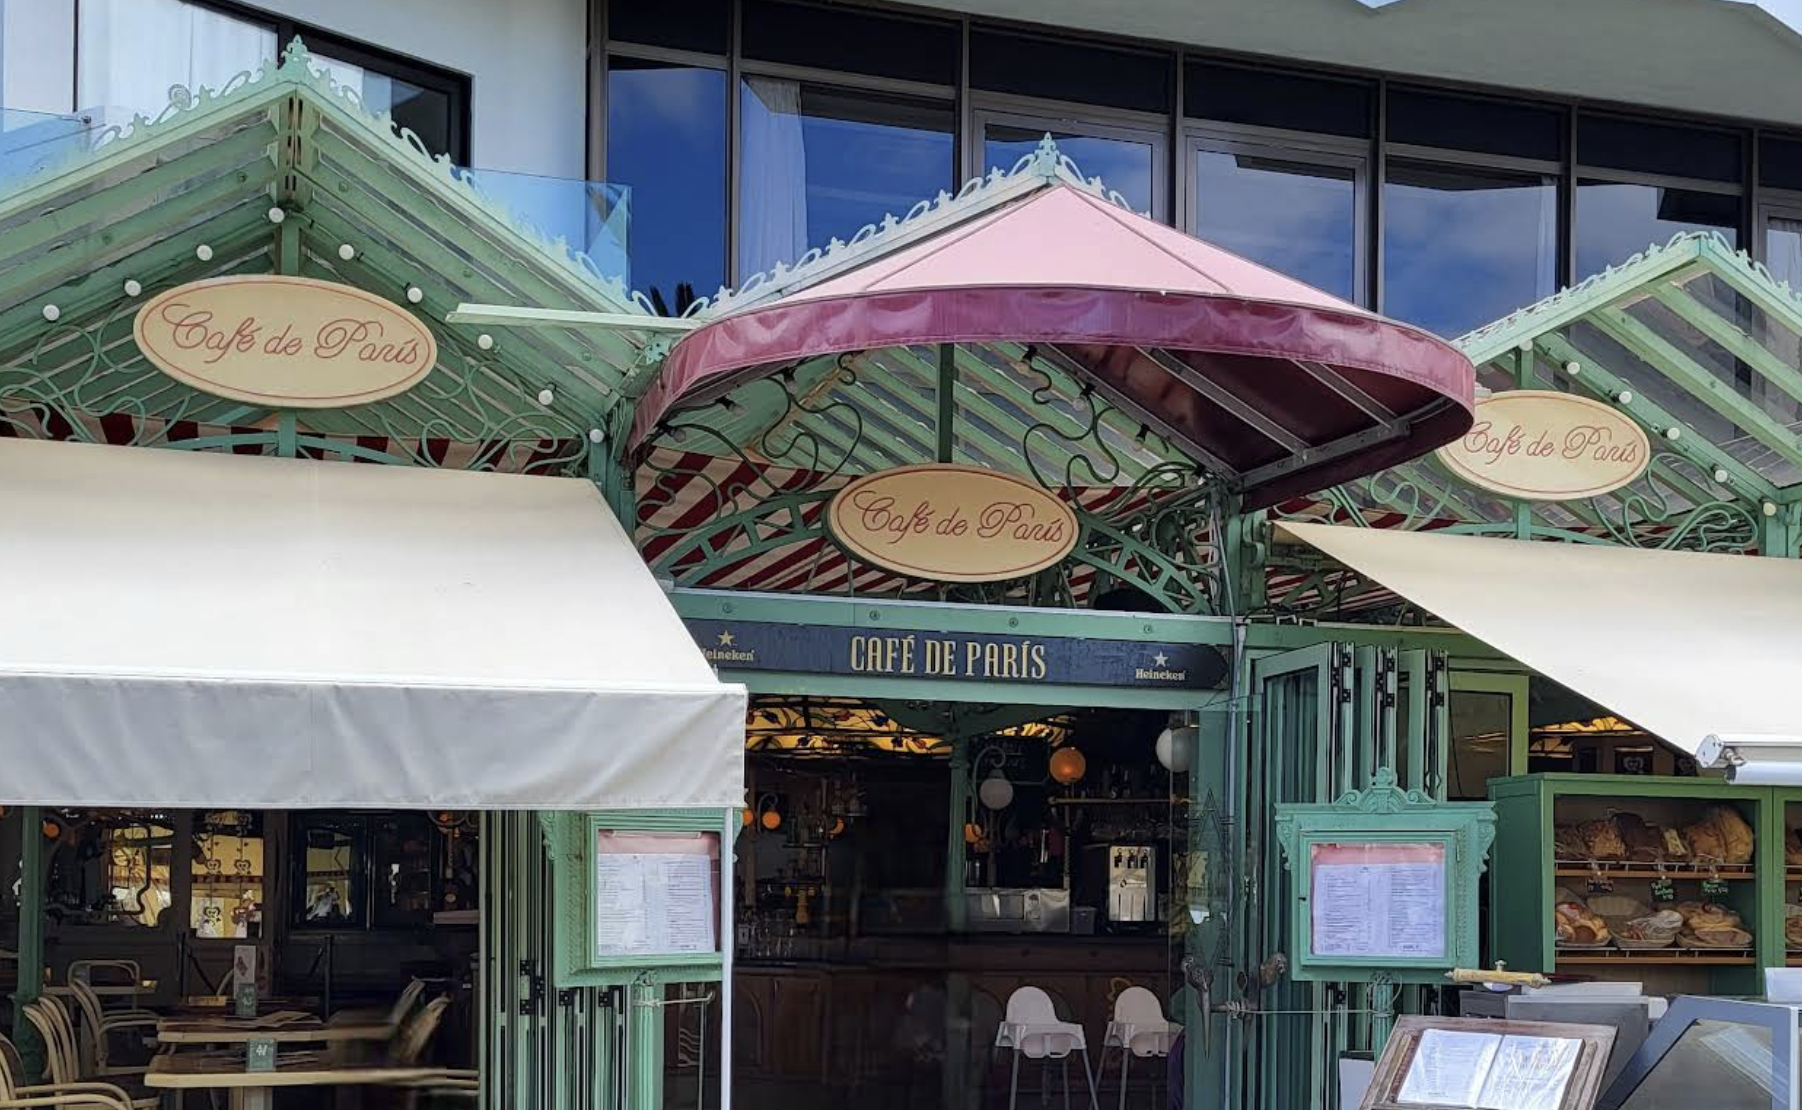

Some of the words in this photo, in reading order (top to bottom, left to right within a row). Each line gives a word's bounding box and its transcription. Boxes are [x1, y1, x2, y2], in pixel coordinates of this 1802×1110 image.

[161, 303, 262, 364] Café
[264, 323, 303, 356] de
[314, 318, 419, 365] París
[1462, 421, 1521, 465] Café
[1526, 430, 1555, 458] de
[1562, 424, 1638, 464] París
[853, 490, 936, 544] Café
[936, 507, 968, 536] de
[977, 501, 1065, 543] París
[851, 634, 916, 674] CAFÉ
[924, 639, 957, 676] DE
[965, 640, 1047, 680] PARÍS
[1135, 668, 1187, 681] Heineken
